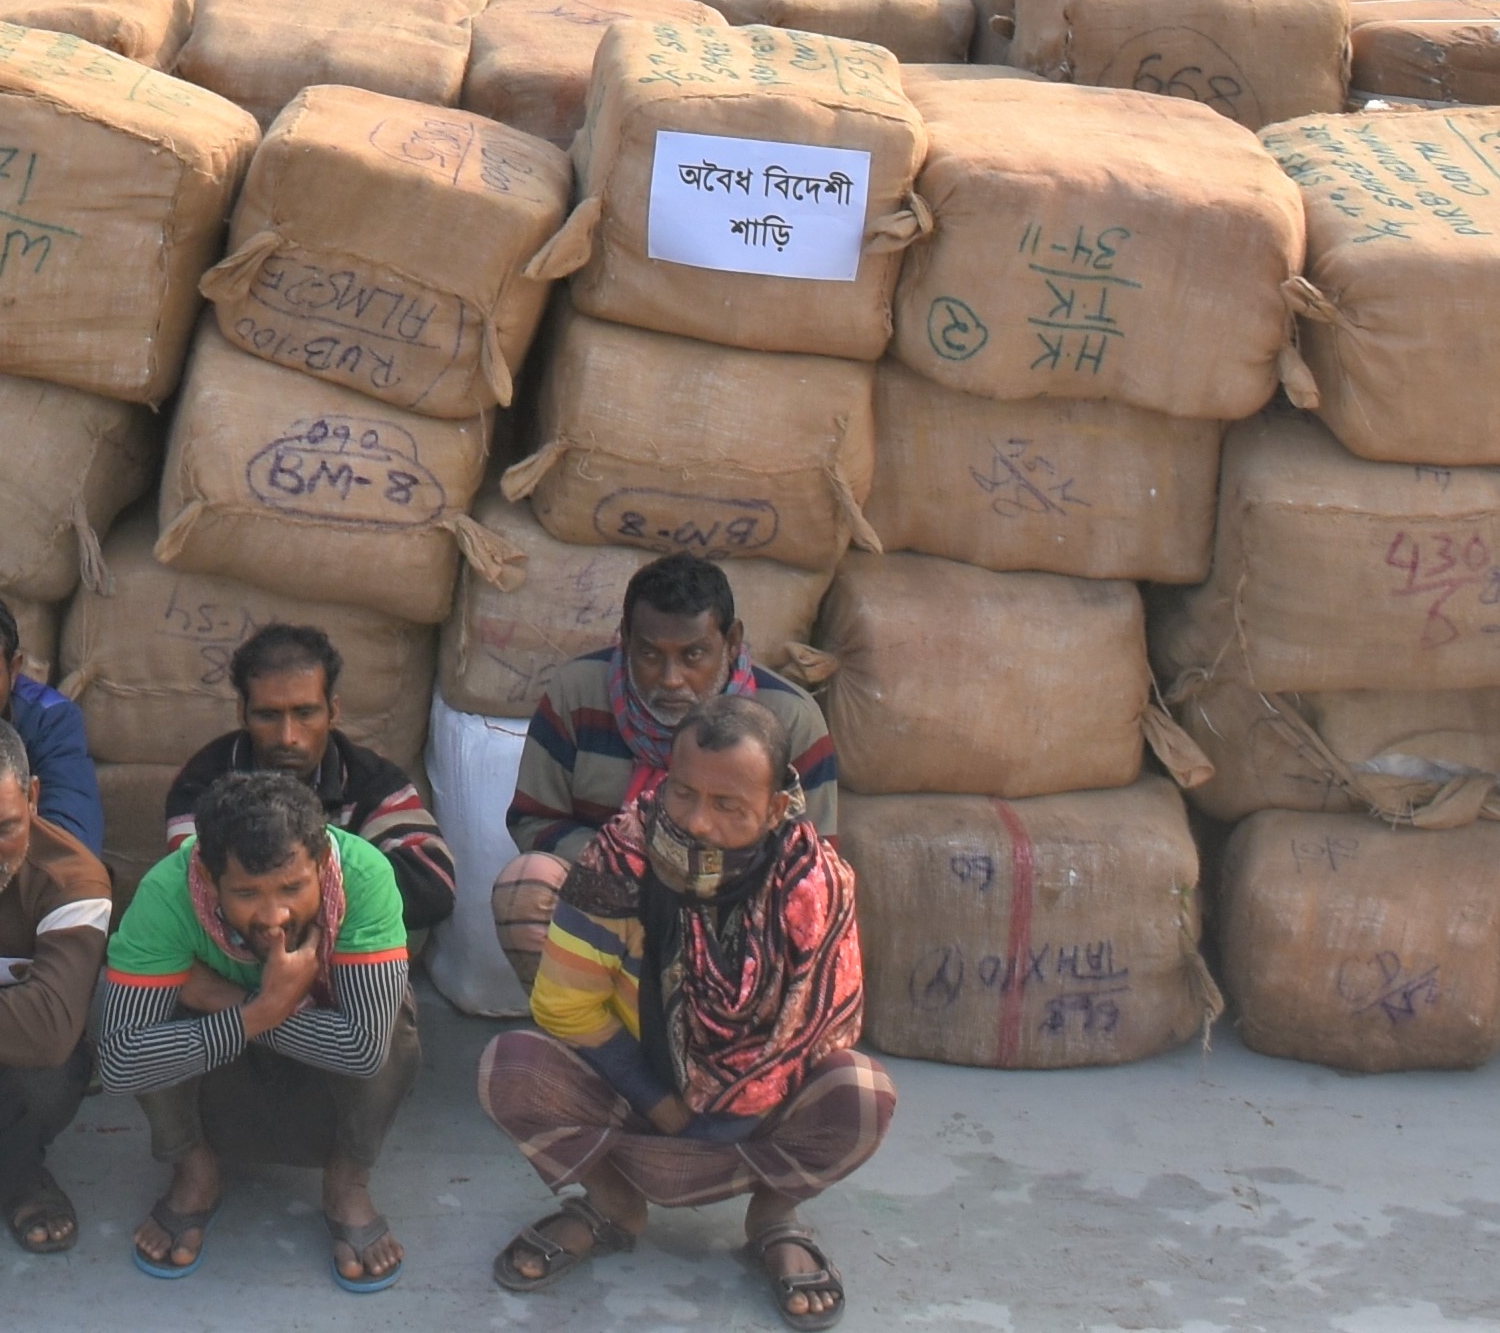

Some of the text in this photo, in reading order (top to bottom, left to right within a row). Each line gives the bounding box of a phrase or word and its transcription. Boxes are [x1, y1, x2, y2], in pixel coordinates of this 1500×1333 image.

[677, 158, 854, 207] অবৈধ বিদেশী
[728, 214, 794, 253] শাড়ি
